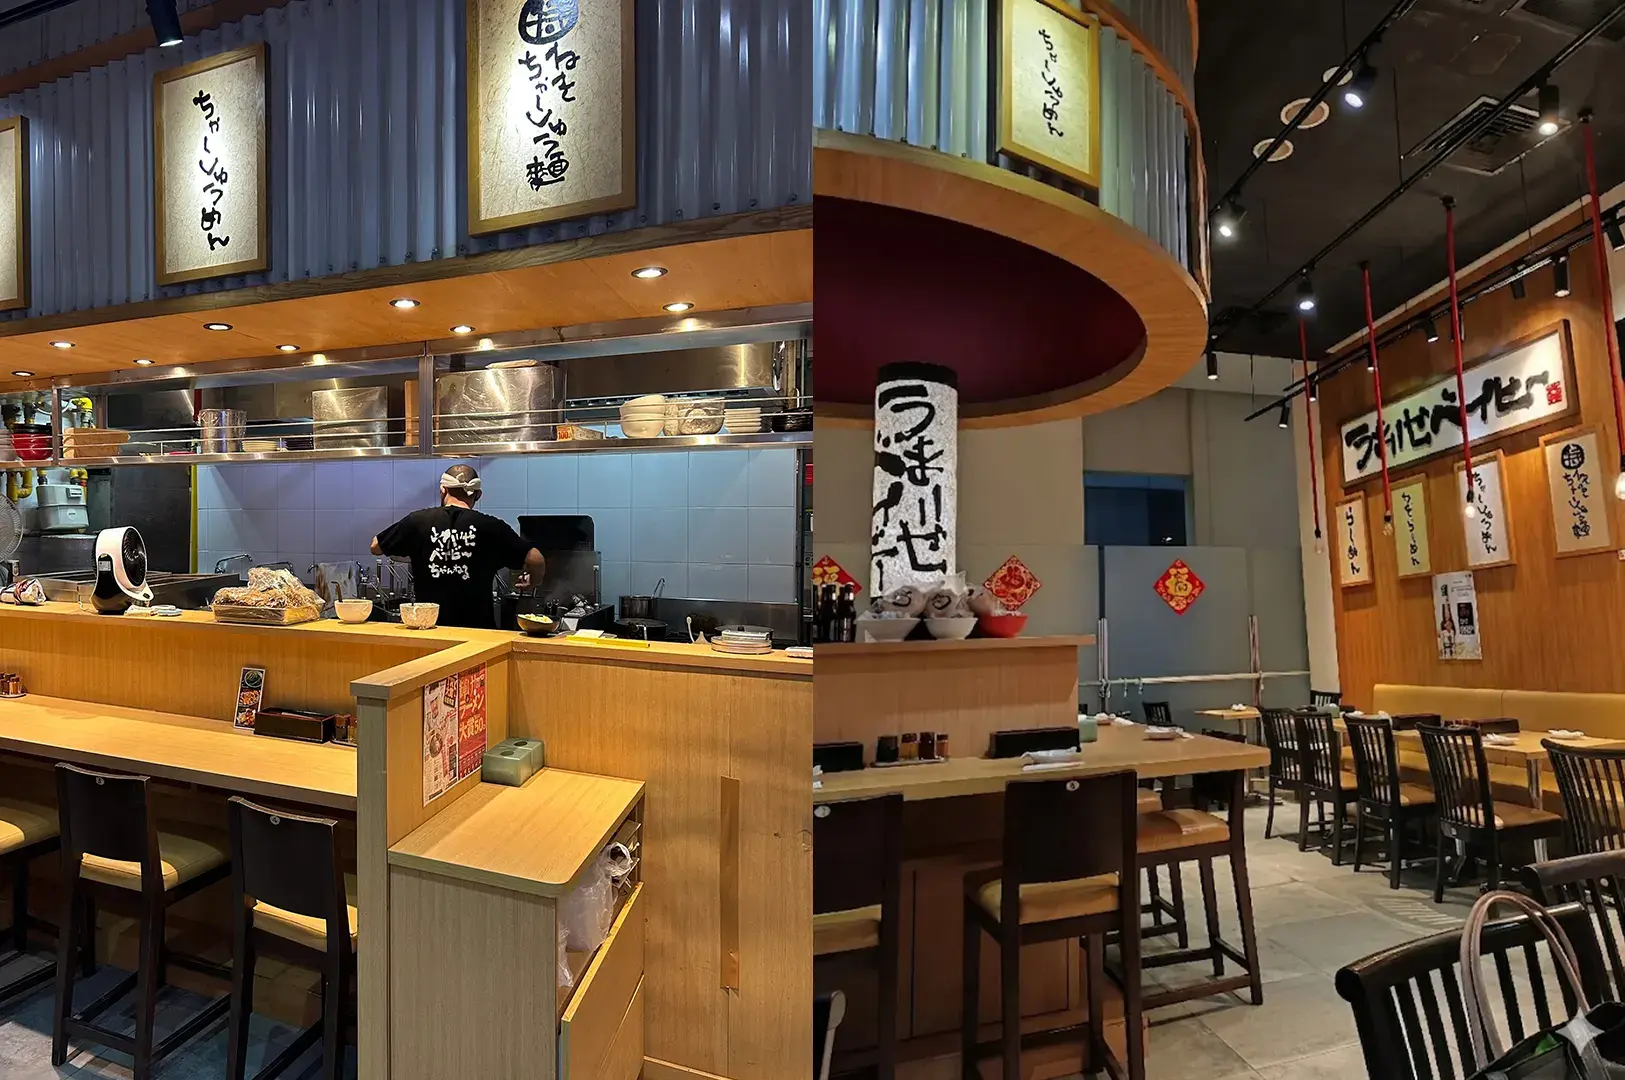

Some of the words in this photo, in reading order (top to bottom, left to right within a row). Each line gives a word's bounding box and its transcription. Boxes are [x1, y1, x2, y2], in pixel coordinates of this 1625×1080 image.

[192, 89, 230, 251] ちゃーしゅうめん
